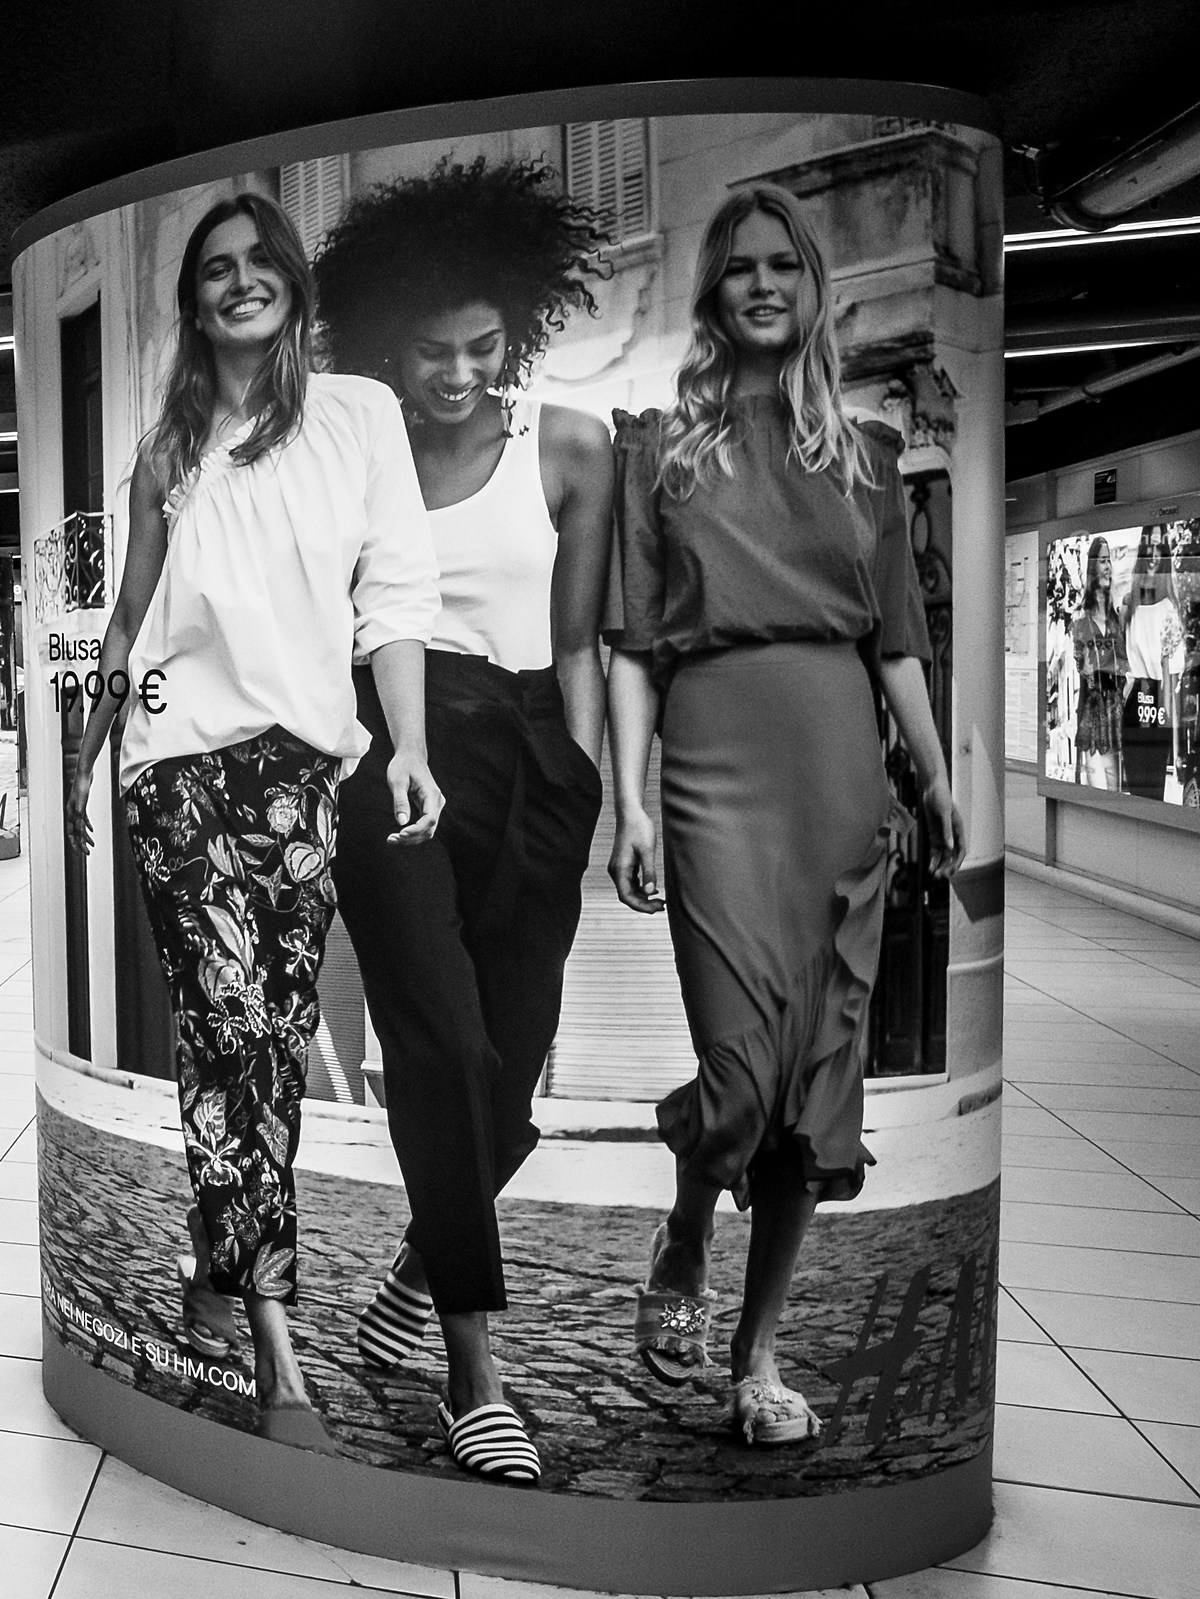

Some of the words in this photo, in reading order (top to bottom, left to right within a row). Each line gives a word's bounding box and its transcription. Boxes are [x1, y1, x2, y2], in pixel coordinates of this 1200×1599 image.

[49, 633, 102, 661] Blusa
[49, 669, 131, 714] 19.99
[138, 668, 168, 715] €
[1137, 705, 1157, 724] 9.99
[1157, 707, 1166, 725] €
[56, 1292, 73, 1320] NEI
[75, 1306, 128, 1350] NEGOZI
[131, 1335, 142, 1357] E
[145, 1342, 170, 1367] SU
[174, 1353, 257, 1398] HM.COM
